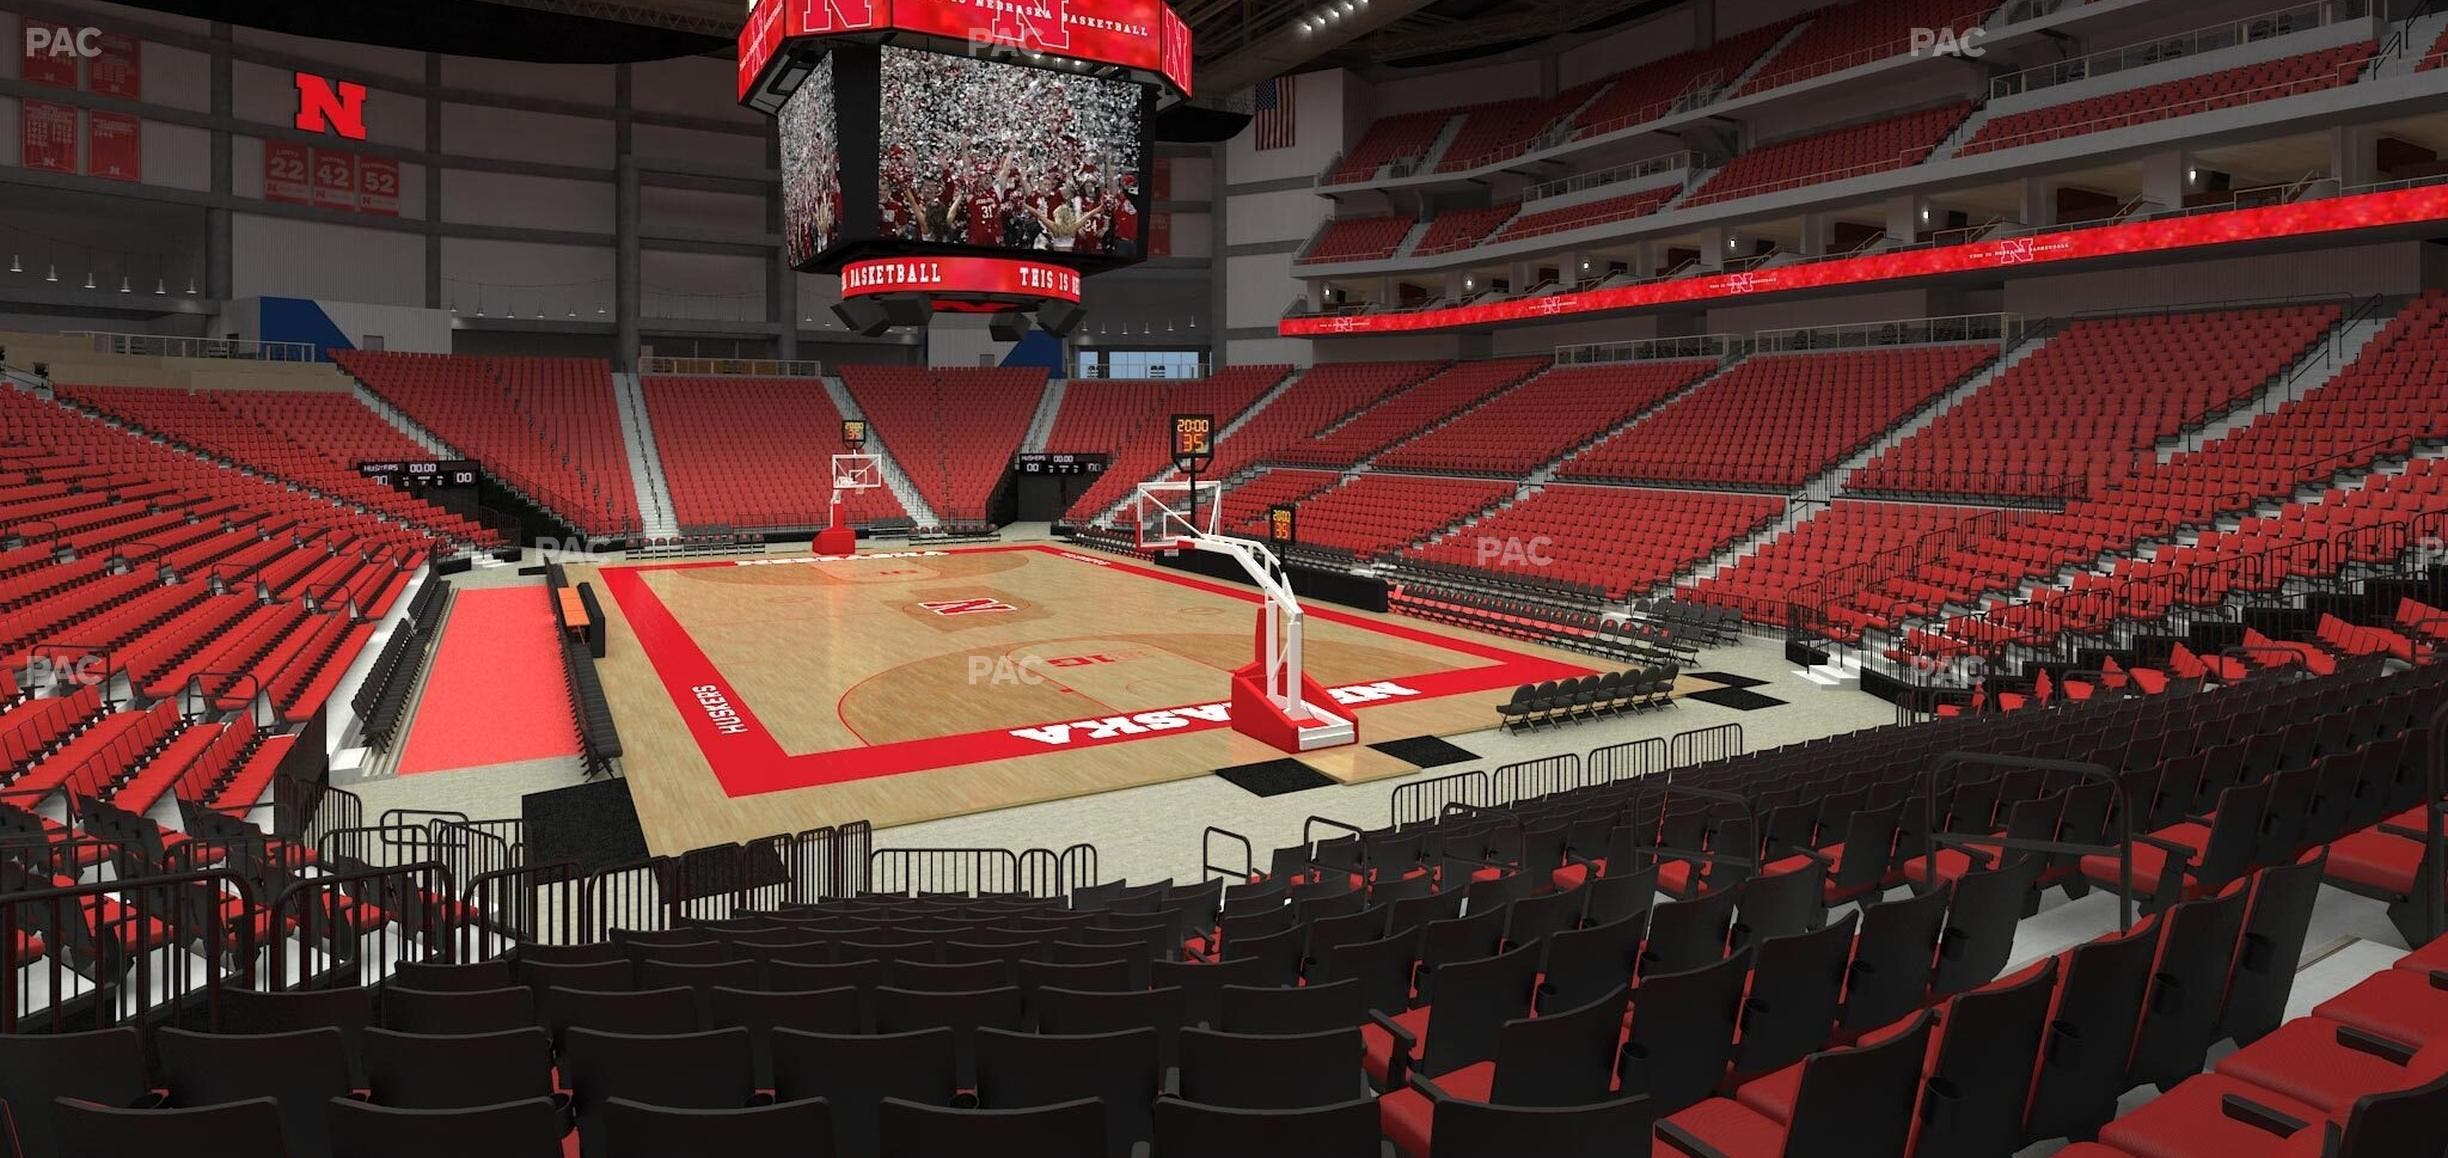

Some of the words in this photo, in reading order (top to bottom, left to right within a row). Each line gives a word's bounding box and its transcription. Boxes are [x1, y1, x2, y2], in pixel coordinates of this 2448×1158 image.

[1063, 13, 1148, 36] BASKETBALL
[296, 72, 367, 140] N
[270, 158, 304, 179] 22
[850, 263, 941, 288] BASKETBALL
[1019, 267, 1053, 289] THIS
[1059, 272, 1068, 292] IS
[1177, 419, 1209, 432] 20:00
[1183, 433, 1204, 452] 35
[456, 472, 473, 483] 00
[1026, 463, 1039, 472] 00
[691, 685, 748, 735] HUSKERS
